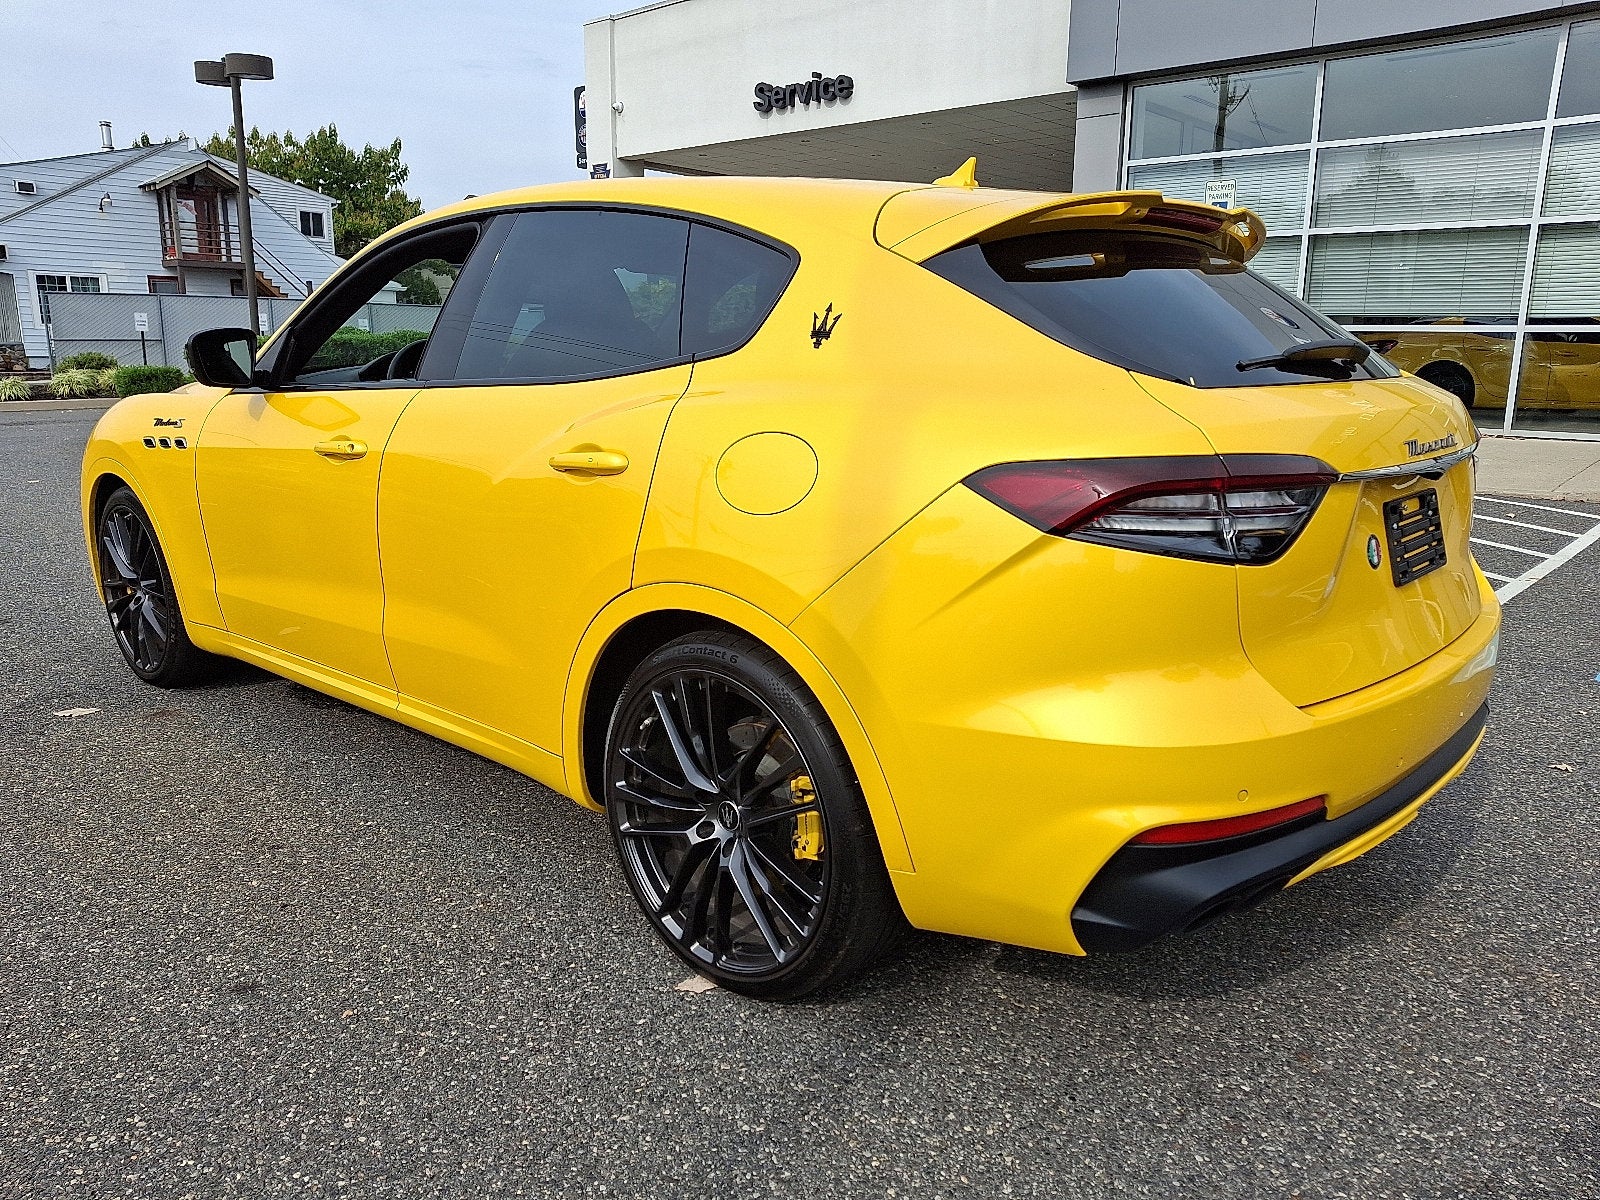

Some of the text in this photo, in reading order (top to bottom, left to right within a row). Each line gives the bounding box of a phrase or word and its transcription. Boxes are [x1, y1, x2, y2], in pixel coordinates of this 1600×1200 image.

[753, 72, 854, 112] Service
[1207, 183, 1235, 192] RESERVED
[1208, 192, 1233, 200] PARKING
[1403, 433, 1458, 457] Maserati
[729, 654, 739, 664] 6
